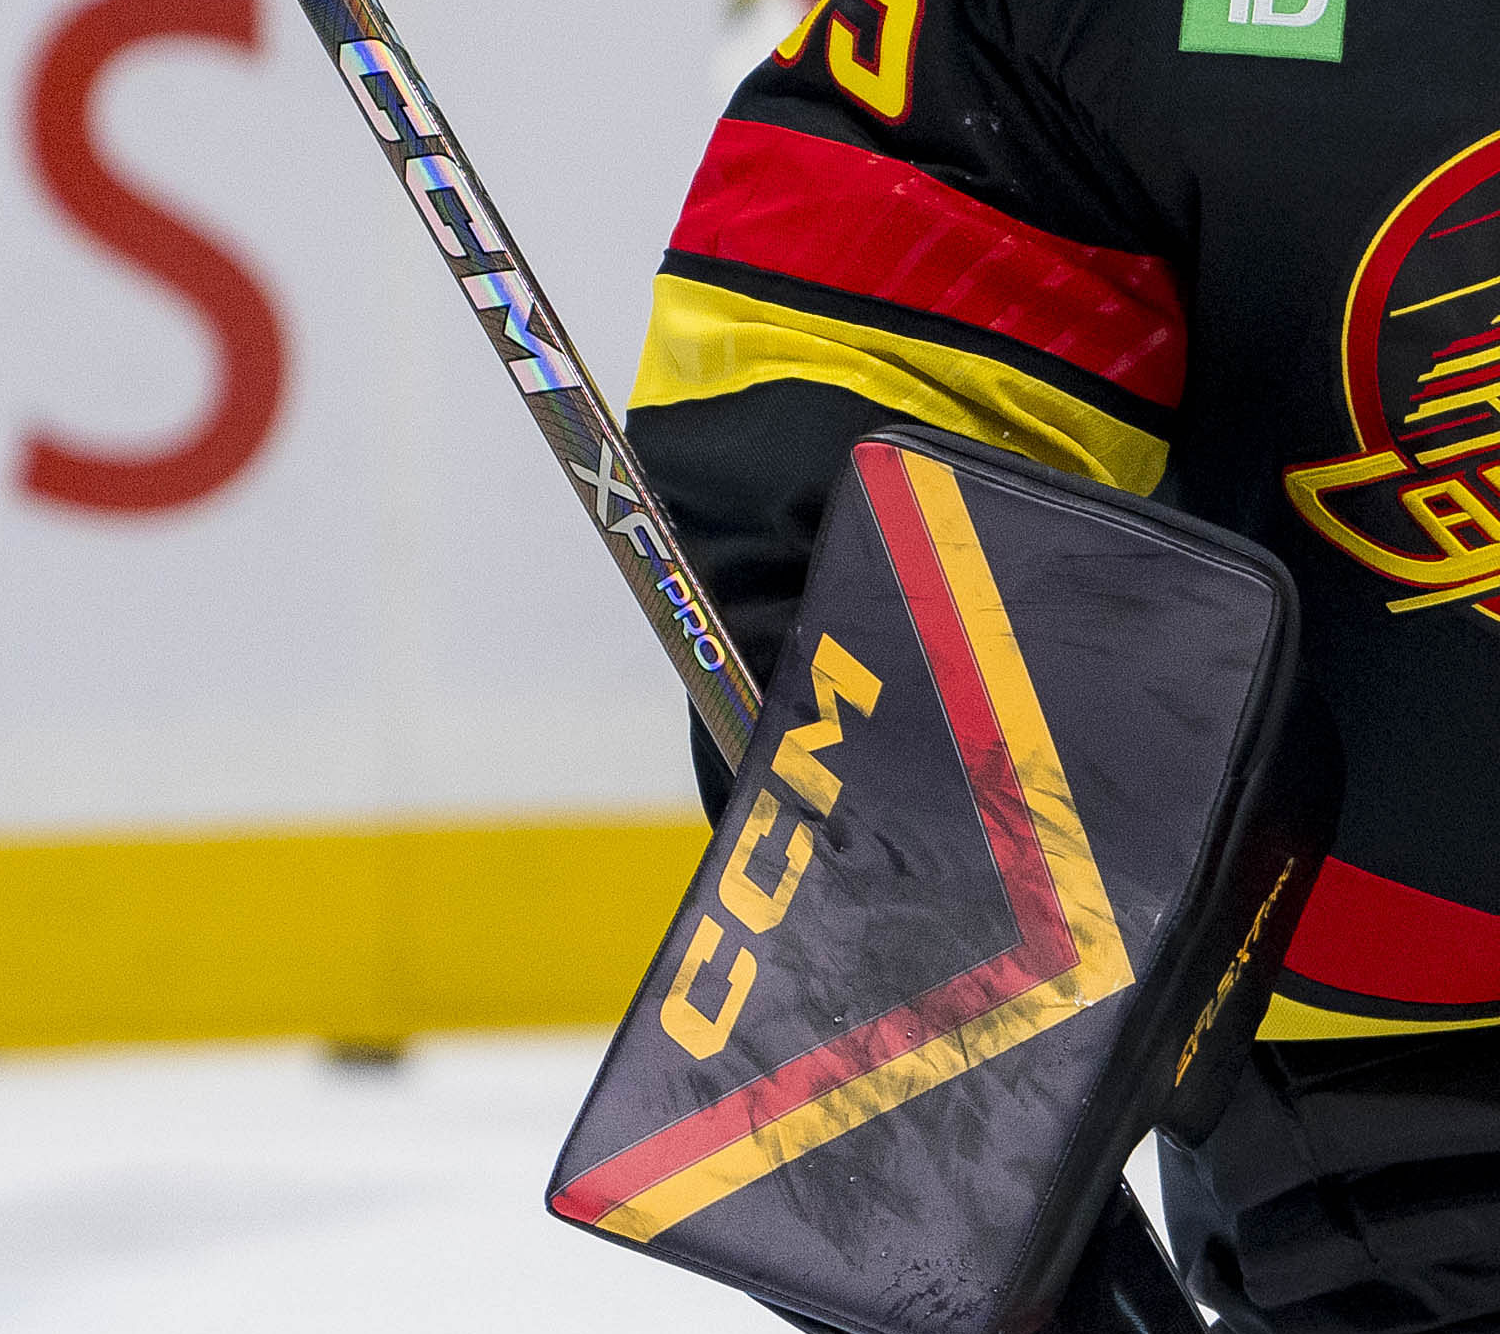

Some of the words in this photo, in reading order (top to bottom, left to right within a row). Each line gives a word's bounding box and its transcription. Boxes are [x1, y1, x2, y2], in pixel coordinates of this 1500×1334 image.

[339, 37, 583, 395] CCM
[566, 436, 675, 561] XF
[656, 569, 727, 673] PRO
[659, 631, 883, 1061] CCM
